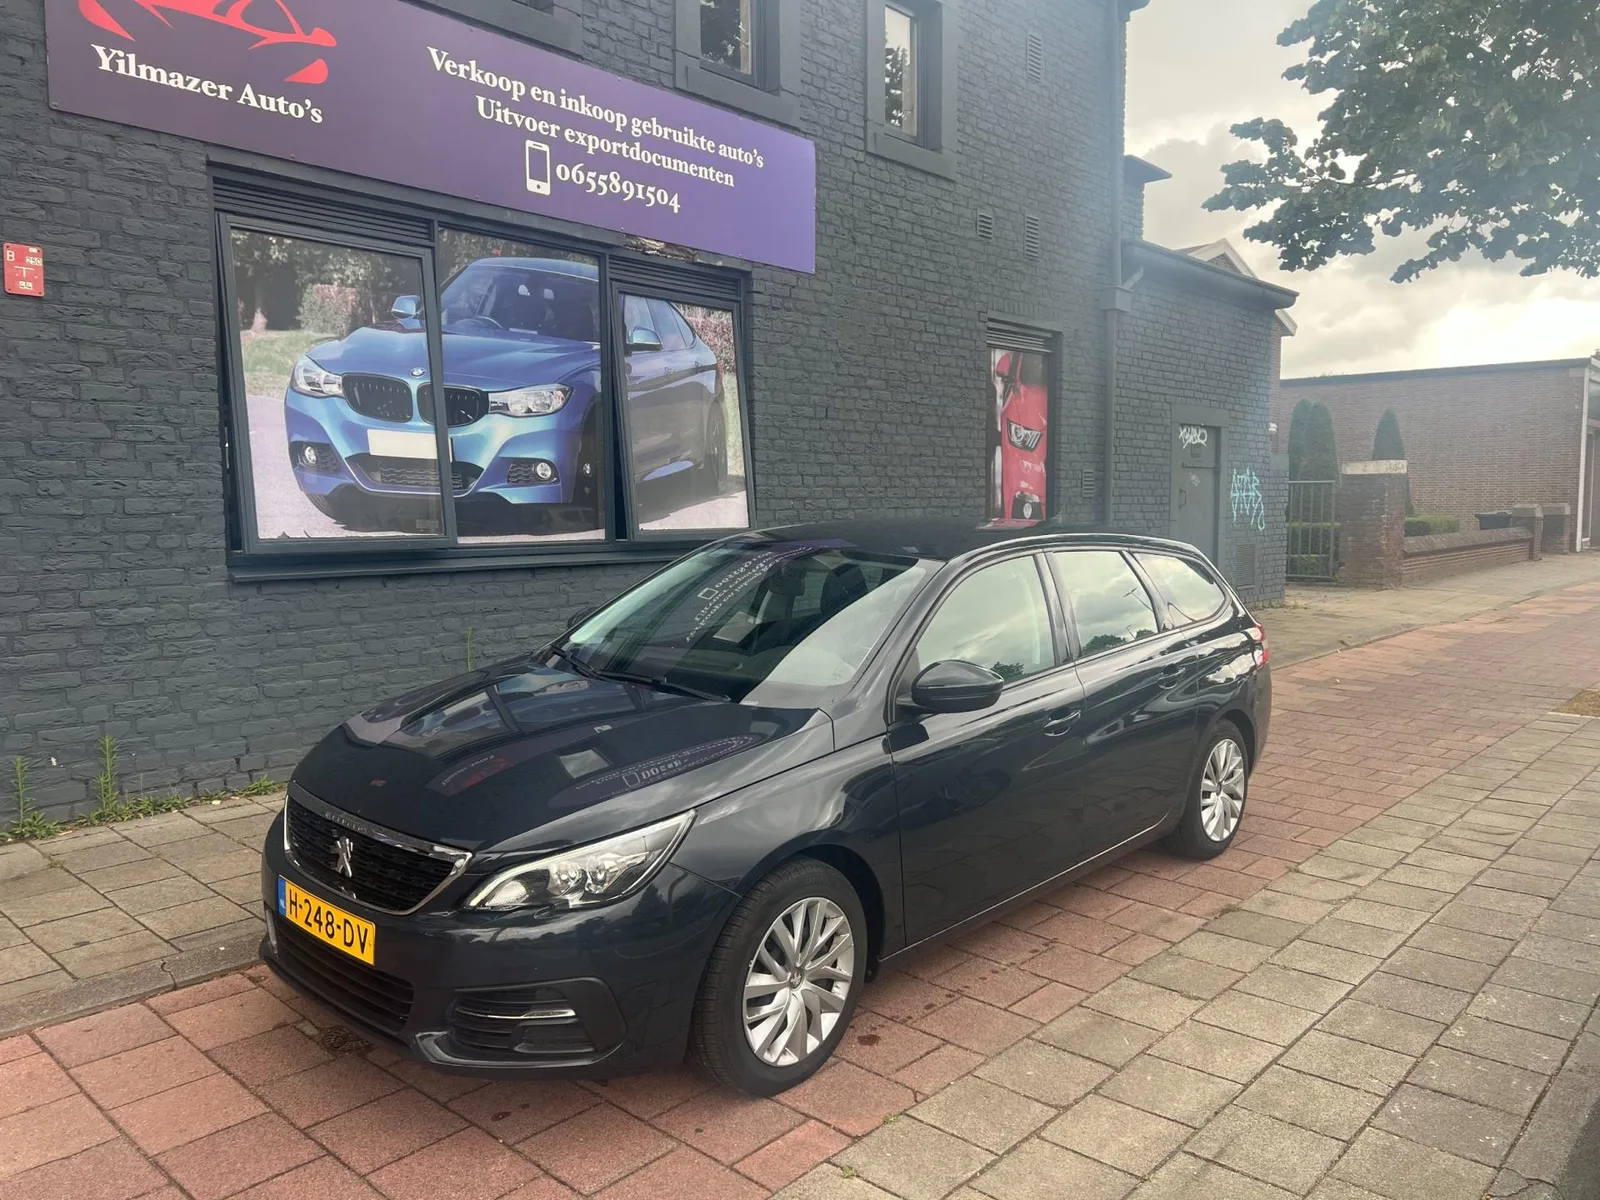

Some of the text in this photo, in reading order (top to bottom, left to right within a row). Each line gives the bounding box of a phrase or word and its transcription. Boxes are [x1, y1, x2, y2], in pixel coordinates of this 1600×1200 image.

[91, 44, 323, 124] Yilmazer Auto's
[427, 46, 764, 169] Verkoop en inkoop gebruikte auto's
[475, 95, 735, 188] Uitvoer exportdocumenten
[556, 163, 681, 214] 0655891504
[7, 250, 15, 261] B
[26, 256, 42, 266] 250
[289, 889, 368, 954] H-248-DV
